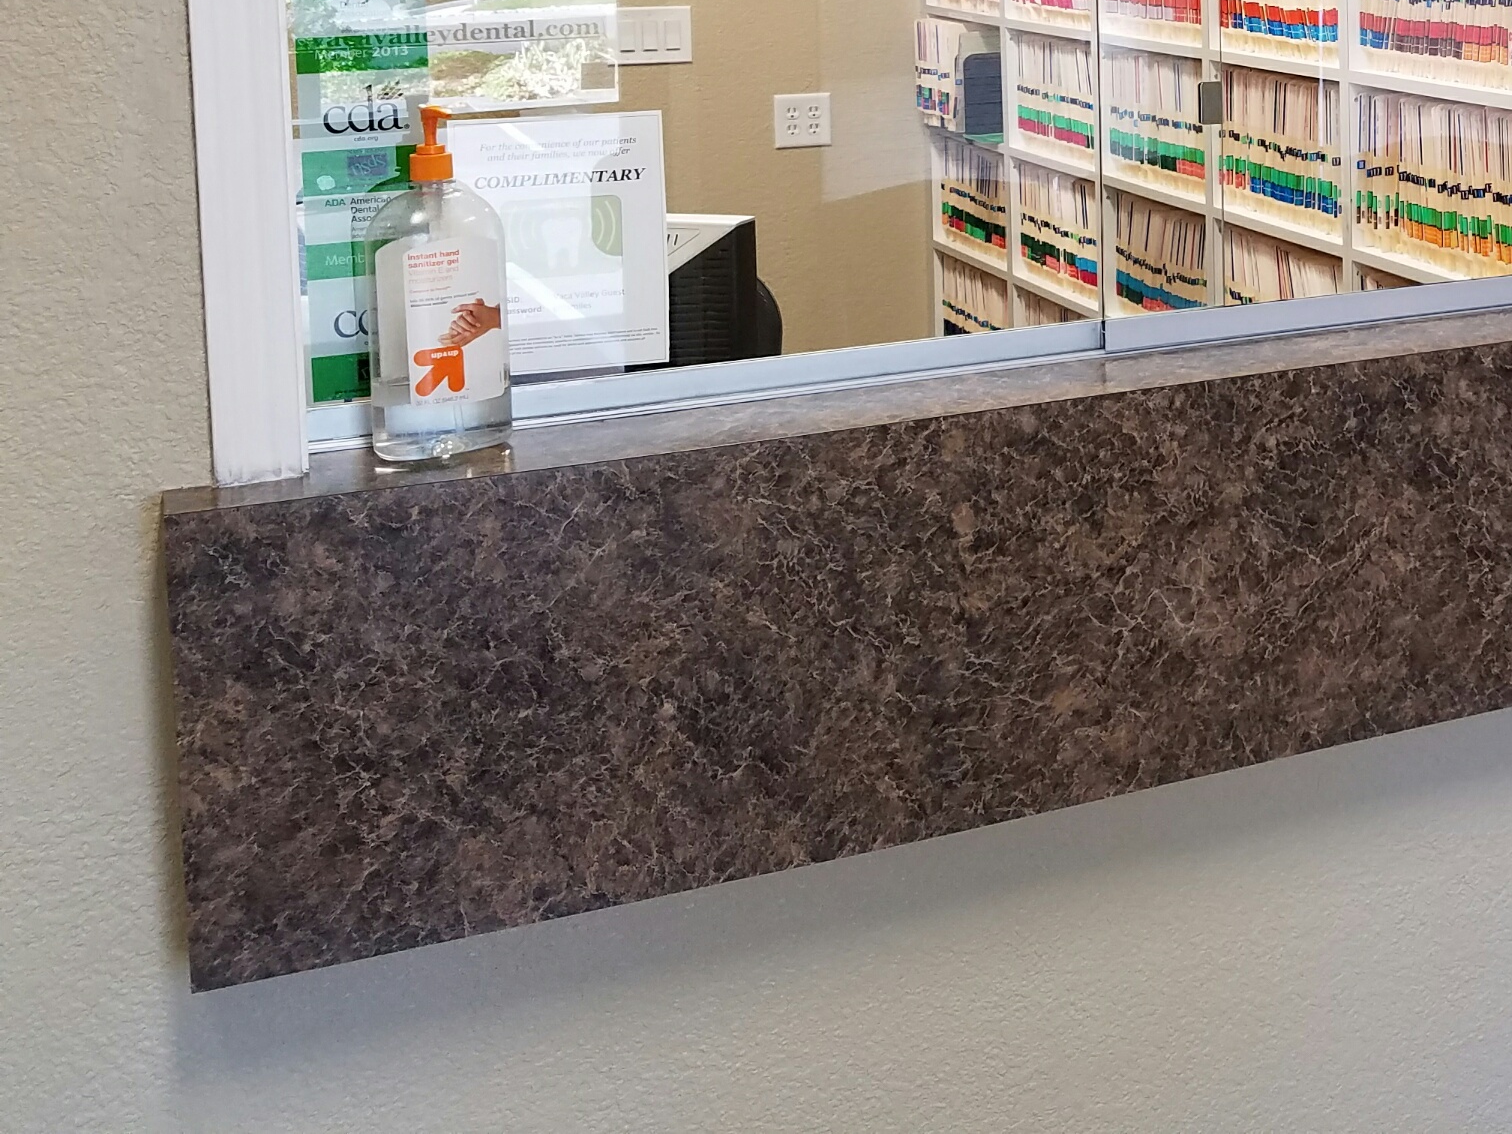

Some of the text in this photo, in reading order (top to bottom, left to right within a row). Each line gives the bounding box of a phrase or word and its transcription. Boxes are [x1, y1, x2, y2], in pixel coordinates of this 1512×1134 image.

[372, 46, 409, 58] 2013
[323, 84, 404, 134] cda
[479, 143, 497, 153] For
[498, 142, 513, 152] the
[572, 138, 583, 149] of
[583, 139, 599, 148] our
[601, 136, 637, 148] patients
[487, 152, 505, 162] and
[507, 151, 530, 162] their
[609, 146, 631, 157] offer
[474, 167, 647, 190] COMPLIMENTARY
[325, 198, 346, 208] ADA
[350, 204, 380, 215] Dental
[407, 249, 460, 261] Instant hand
[408, 257, 460, 269] sanitizer gel
[601, 288, 626, 297] Guest
